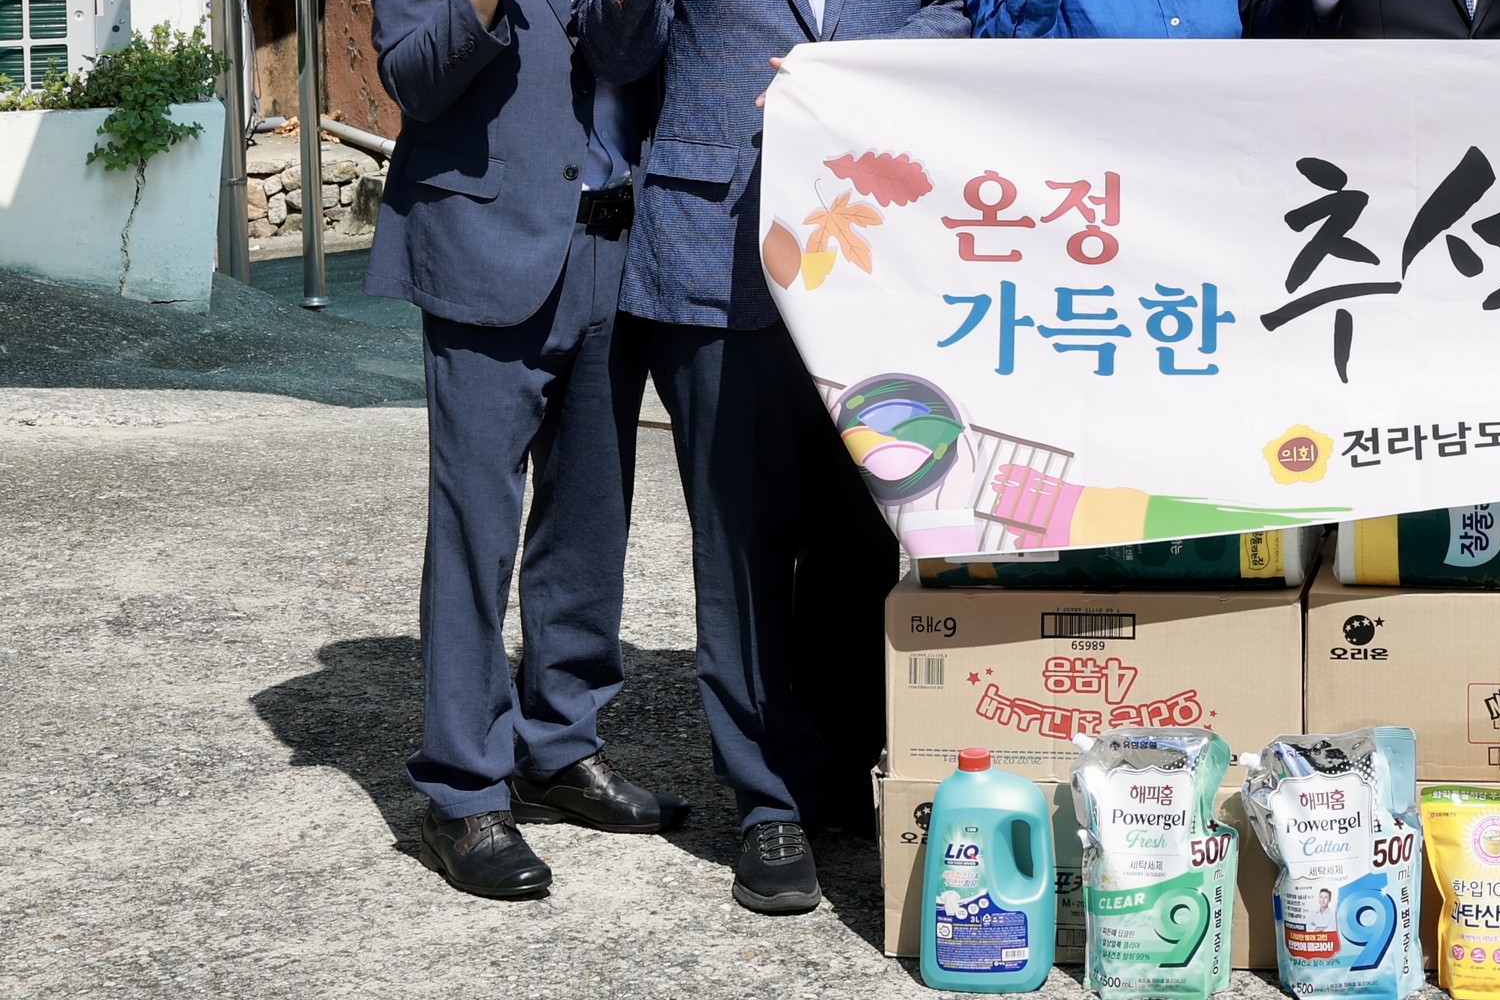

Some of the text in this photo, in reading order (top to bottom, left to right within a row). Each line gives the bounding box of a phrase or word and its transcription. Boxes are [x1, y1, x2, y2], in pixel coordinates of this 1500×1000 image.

[941, 170, 1122, 265] 온정
[936, 280, 1236, 377] 가득한
[1278, 444, 1315, 465] 의회
[910, 614, 958, 639] 6개입
[1071, 640, 1106, 653] 68659
[1329, 647, 1390, 661] 오리온
[1042, 656, 1139, 705] 4묶음
[1130, 785, 1174, 806] 해피홈
[1299, 788, 1346, 811] 해피홈
[1112, 808, 1186, 830] Powergel
[1285, 810, 1362, 835] Powergel
[1125, 829, 1168, 849] Fresh
[1299, 836, 1352, 857] Cotton
[944, 843, 980, 860] LiQ
[1190, 833, 1233, 868] 500
[1373, 833, 1415, 868] 500
[1128, 859, 1163, 872] 세탁세제
[1098, 891, 1146, 911] CLEAR
[1135, 953, 1151, 961] 99%
